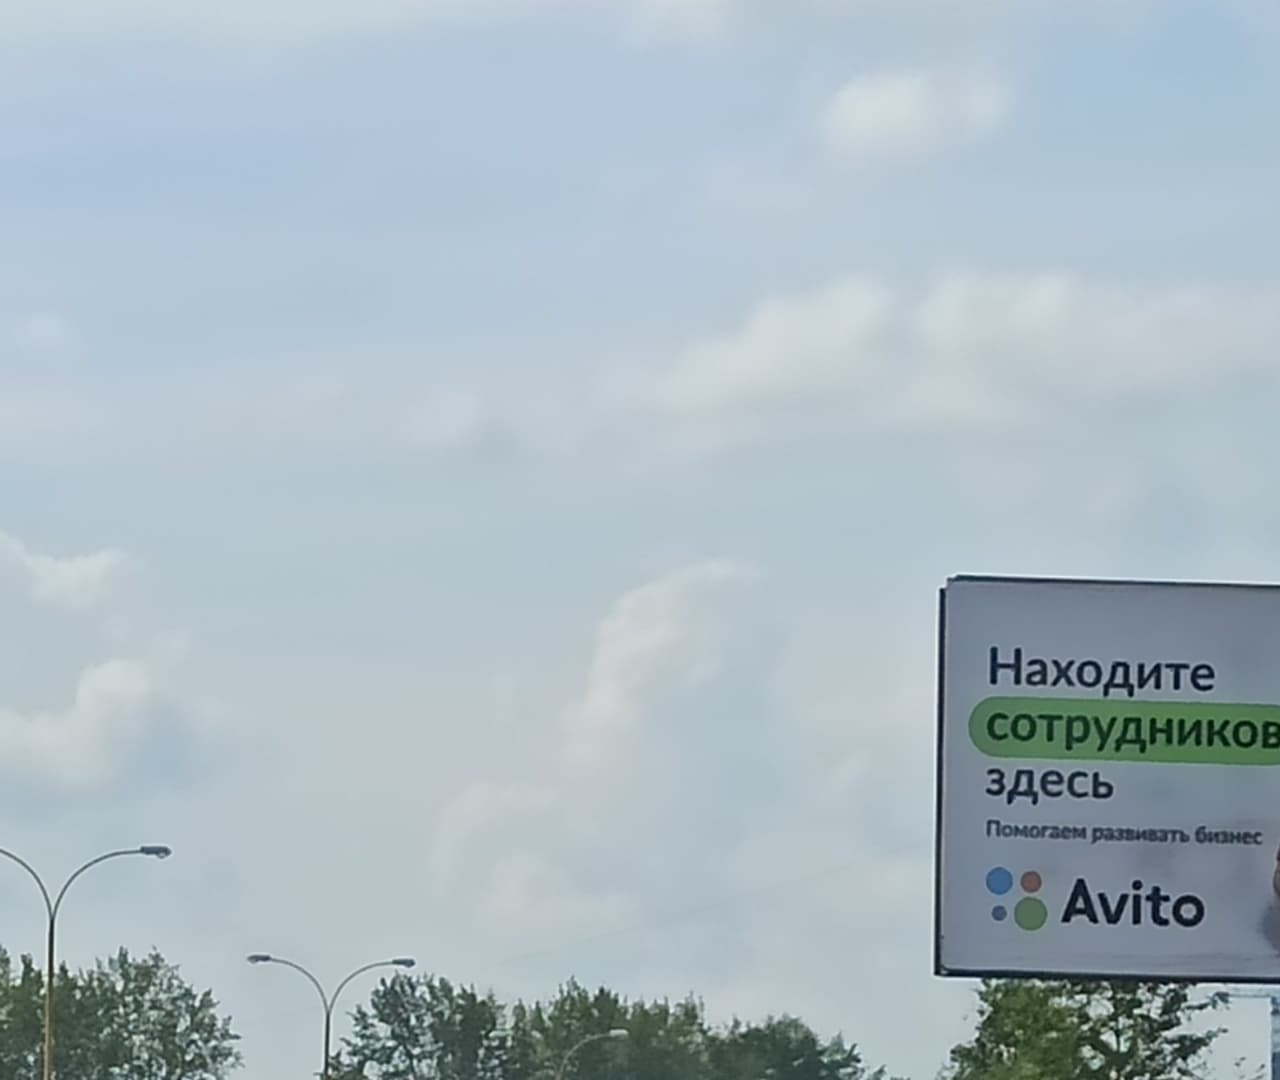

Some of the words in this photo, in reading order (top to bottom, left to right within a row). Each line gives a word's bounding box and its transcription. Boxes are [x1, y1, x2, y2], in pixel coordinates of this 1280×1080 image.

[988, 646, 1216, 698] Находите
[984, 767, 1115, 806] здесь
[985, 819, 1087, 841] Помогаем
[1091, 825, 1191, 845] развивать
[1194, 826, 1264, 846] бизнес
[1060, 877, 1206, 928] Avito
